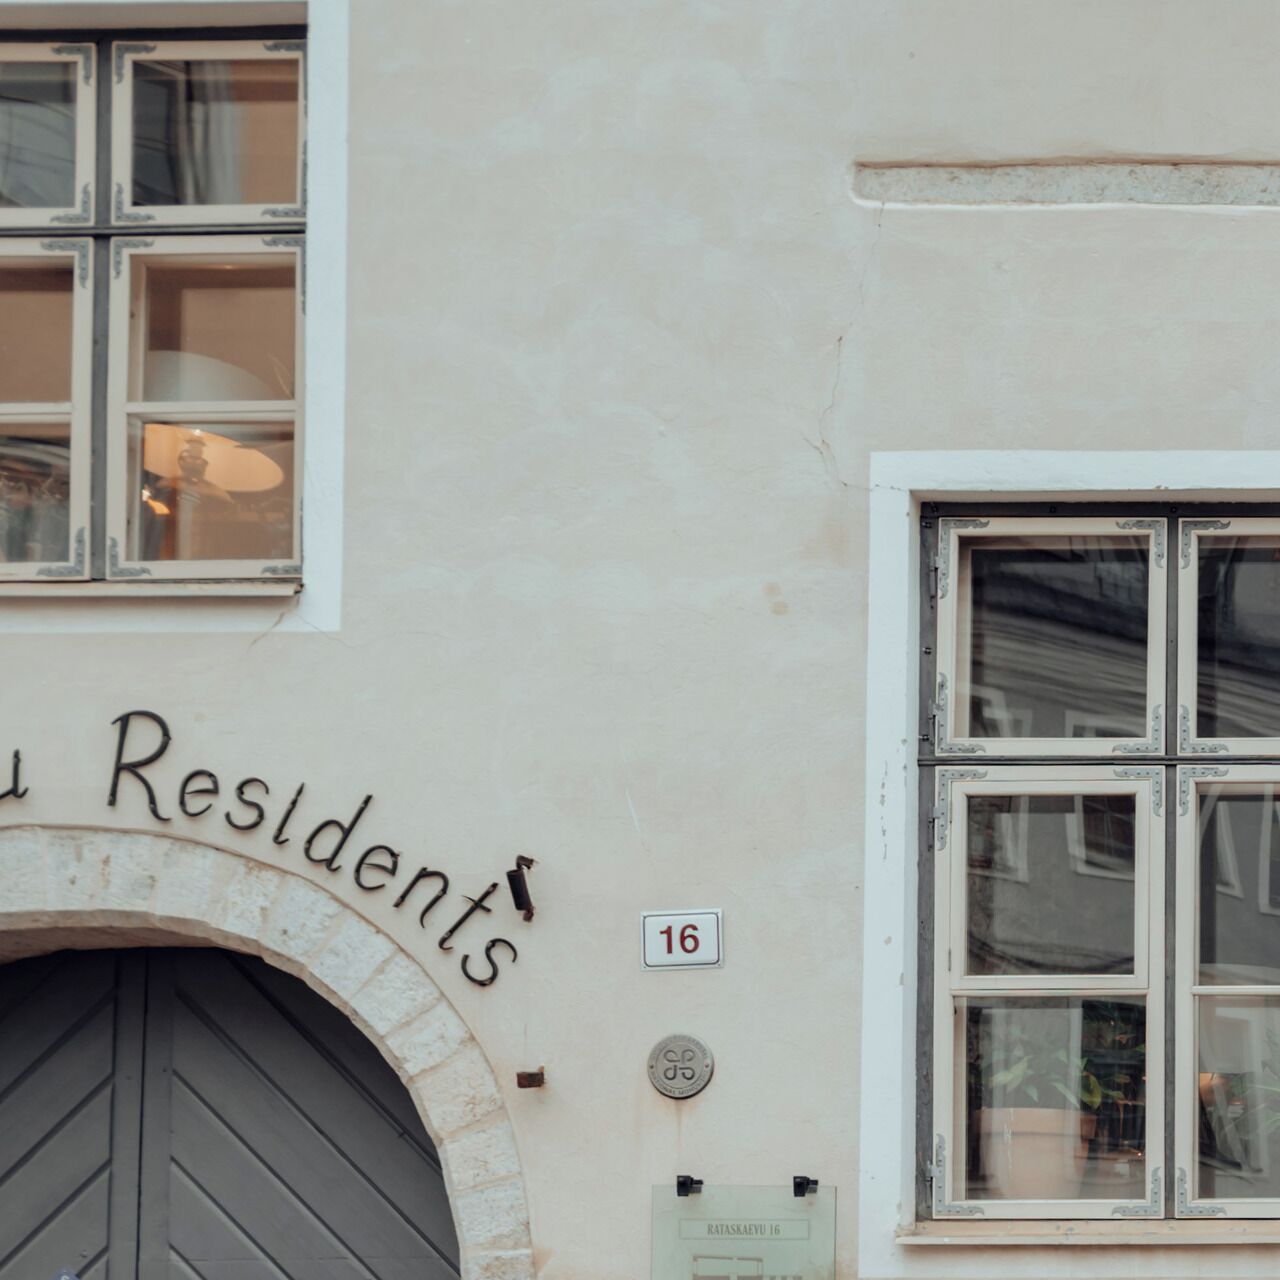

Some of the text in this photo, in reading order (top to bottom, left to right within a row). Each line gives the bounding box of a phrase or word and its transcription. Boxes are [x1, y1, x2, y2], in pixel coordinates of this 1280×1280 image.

[106, 709, 518, 988] Residents
[658, 923, 700, 955] 16
[707, 1223, 781, 1236] RATASKAEVU 16
